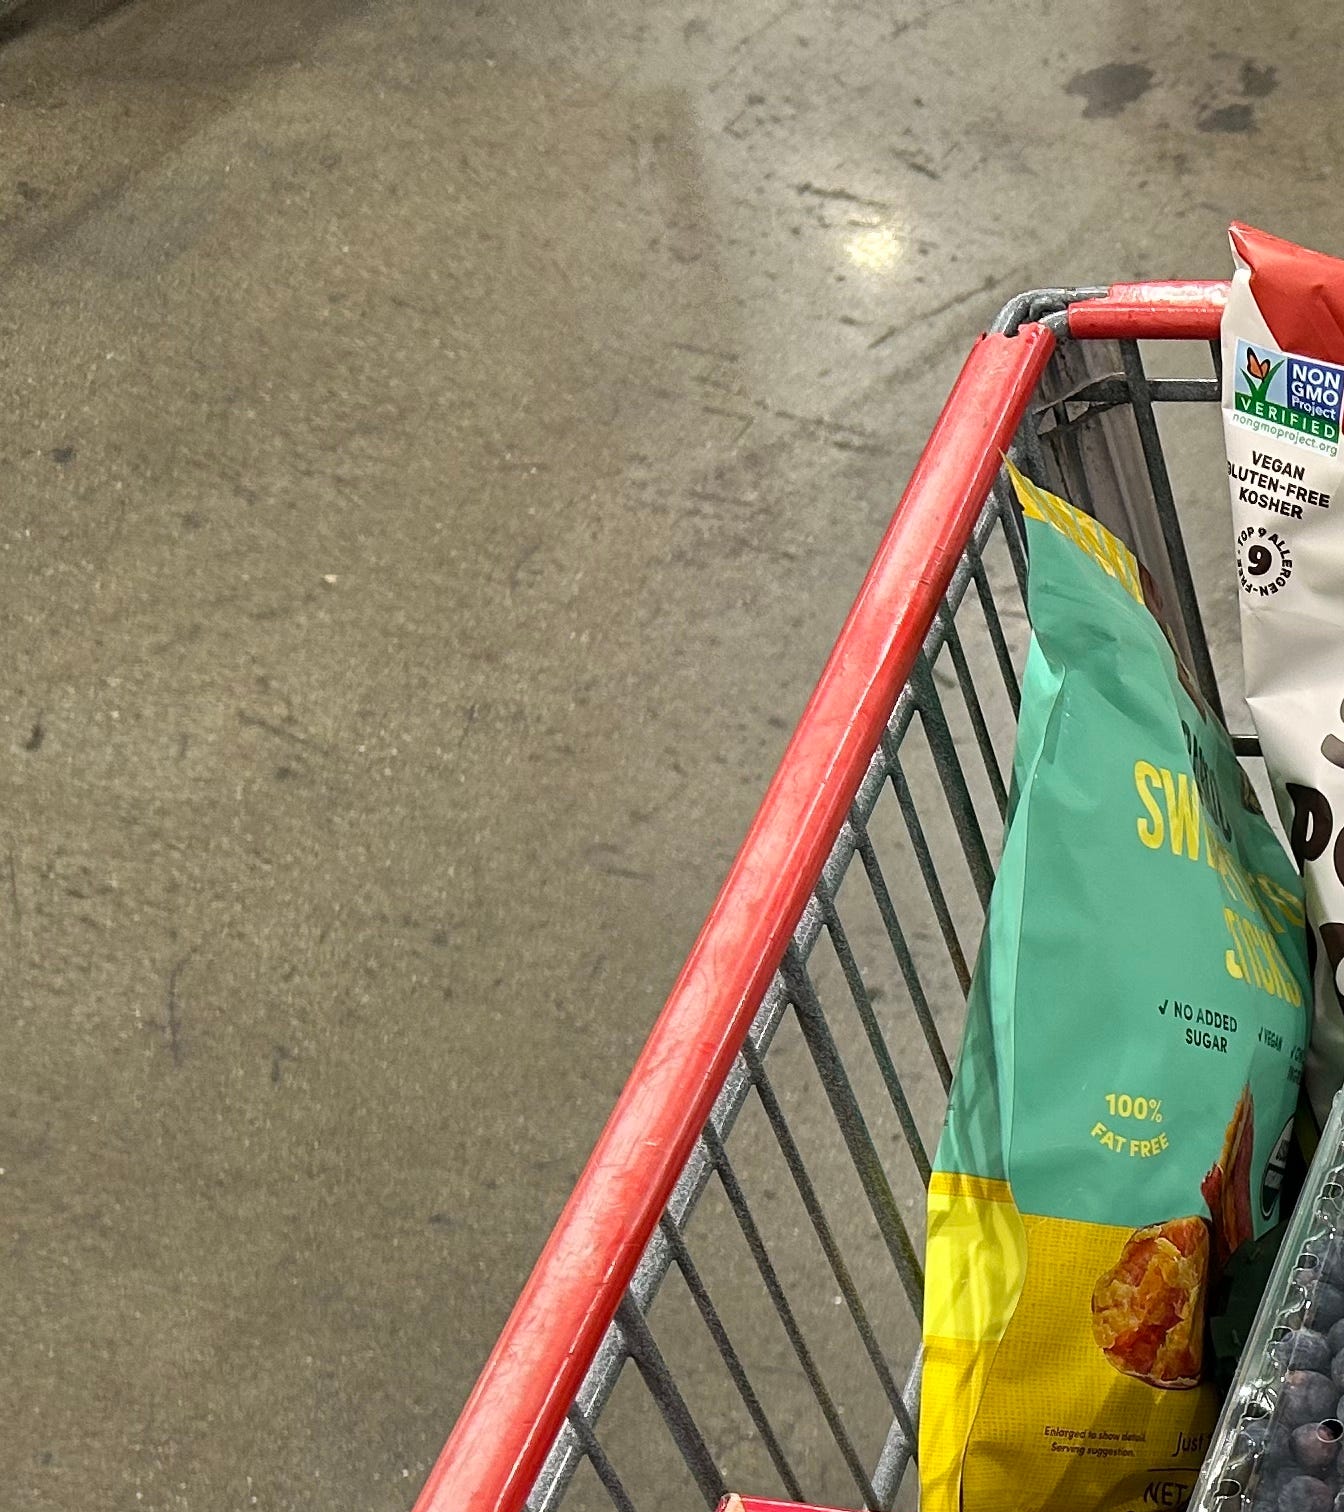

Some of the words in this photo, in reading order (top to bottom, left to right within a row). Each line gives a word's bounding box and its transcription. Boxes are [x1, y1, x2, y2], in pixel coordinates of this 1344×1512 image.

[1292, 363, 1341, 389] NON
[1291, 381, 1339, 406] GMO
[1291, 397, 1337, 421] Project
[1240, 397, 1336, 439] VERIFIED
[1232, 413, 1338, 457] nongmoproject.org
[1251, 450, 1305, 481] VEGAN
[1239, 487, 1303, 519] KOSHER
[1247, 544, 1273, 576] 9
[1174, 1000, 1194, 1021] NO
[1196, 1006, 1238, 1034] ADDED
[1185, 1027, 1229, 1053] SUGAR
[1105, 1093, 1163, 1123] 100%
[1090, 1122, 1127, 1153] FAT
[1129, 1132, 1170, 1158] FREE
[1144, 1481, 1185, 1504] NET
